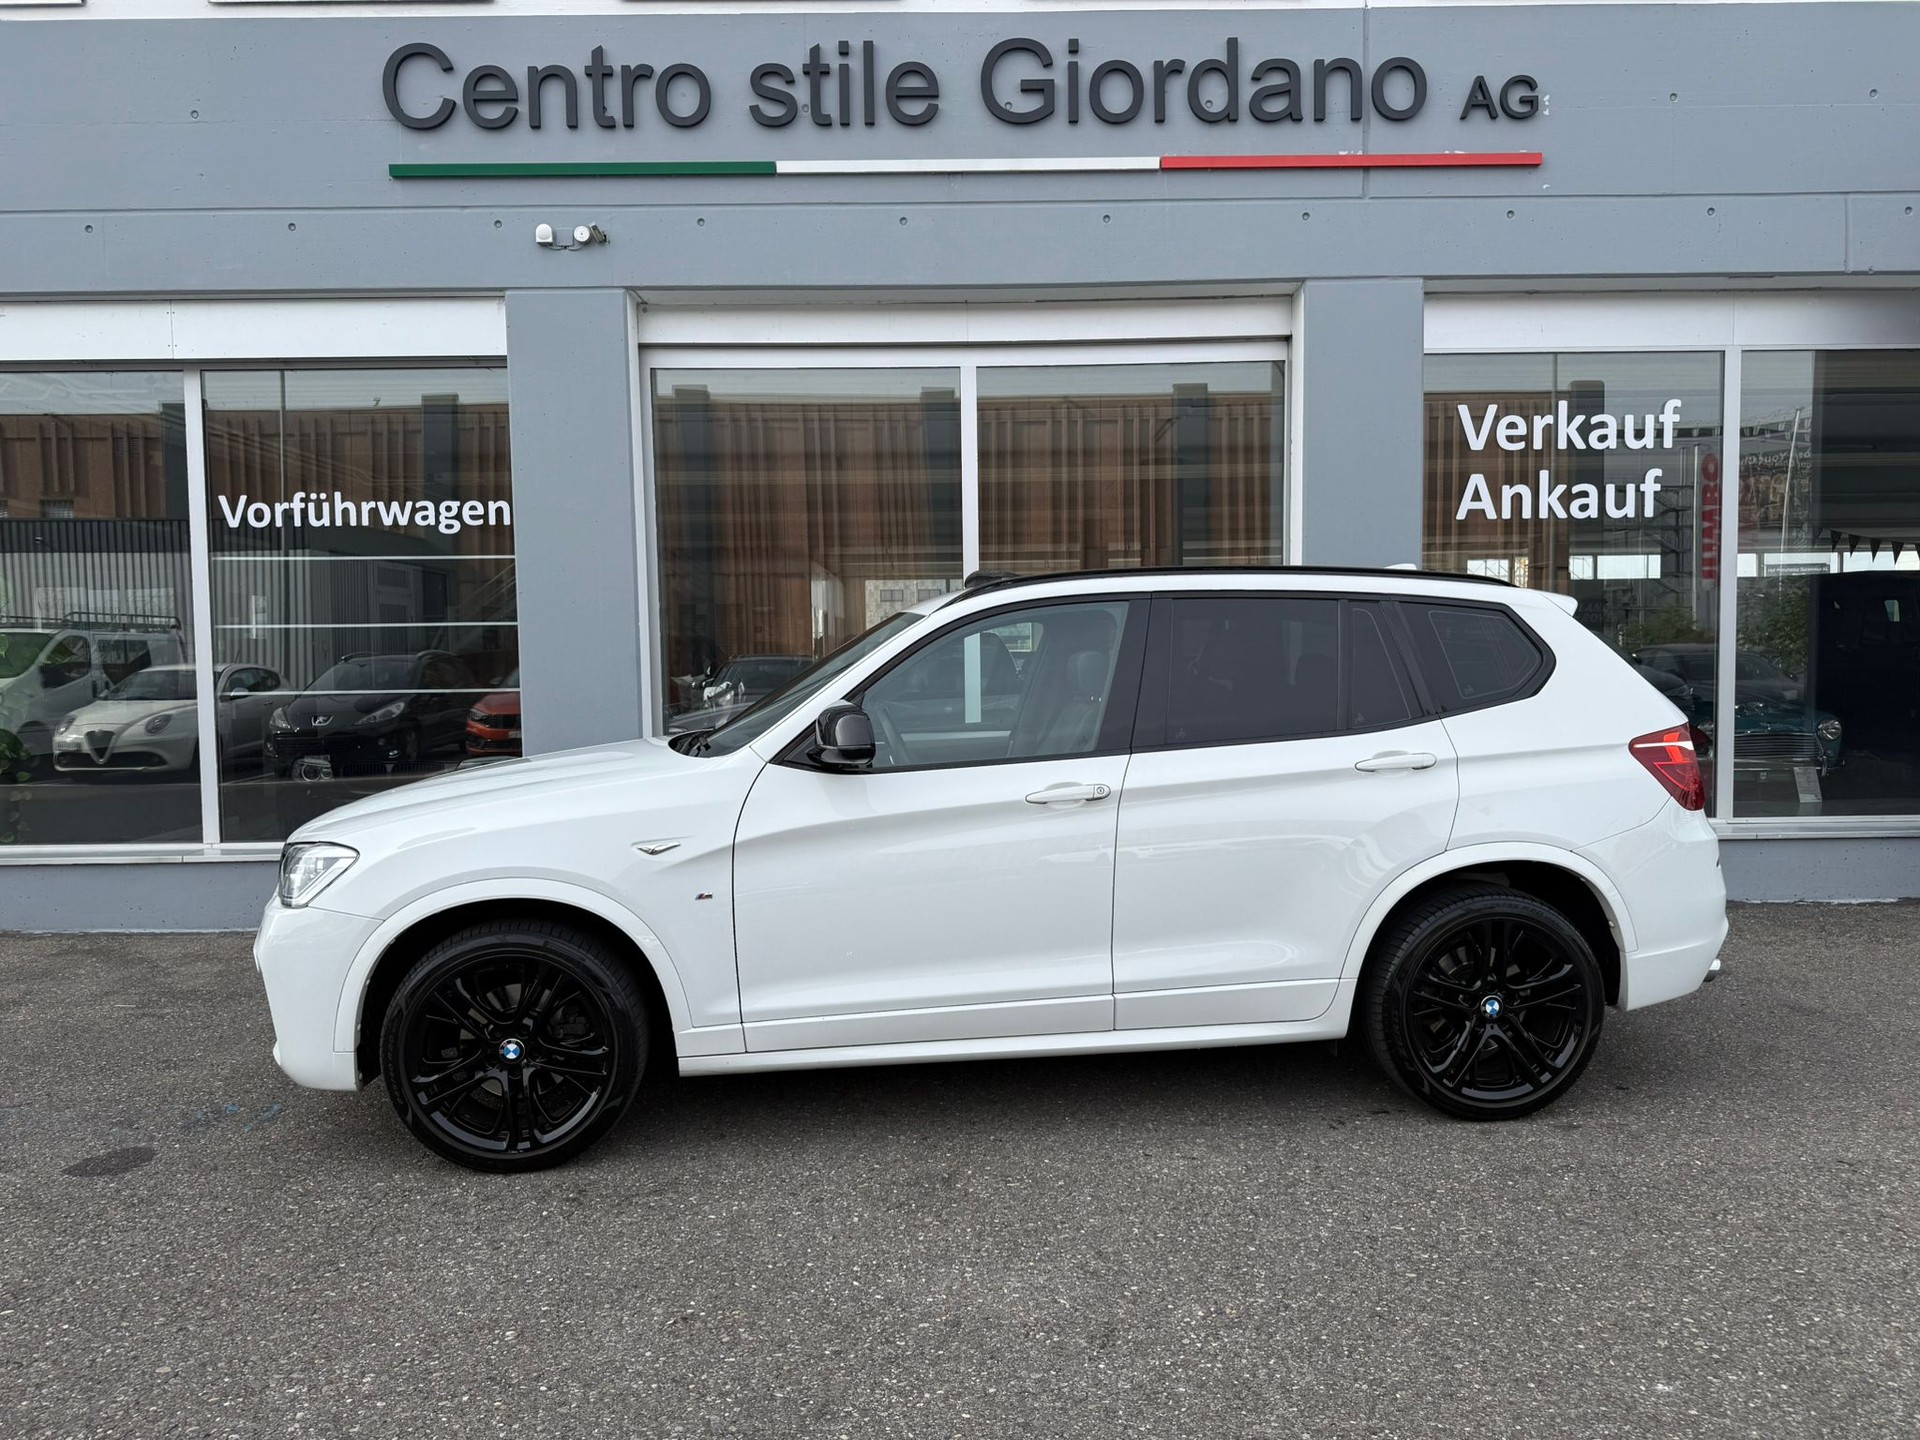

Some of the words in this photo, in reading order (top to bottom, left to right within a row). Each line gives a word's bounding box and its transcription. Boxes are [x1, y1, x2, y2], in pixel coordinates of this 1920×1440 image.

[382, 42, 712, 134] Centro
[749, 40, 940, 131] stile
[981, 36, 1428, 128] Giordano
[1460, 74, 1540, 122] AG
[1457, 398, 1682, 451] Verkauf
[218, 491, 511, 534] Vorführwagen
[1456, 468, 1663, 520] Ankauf
